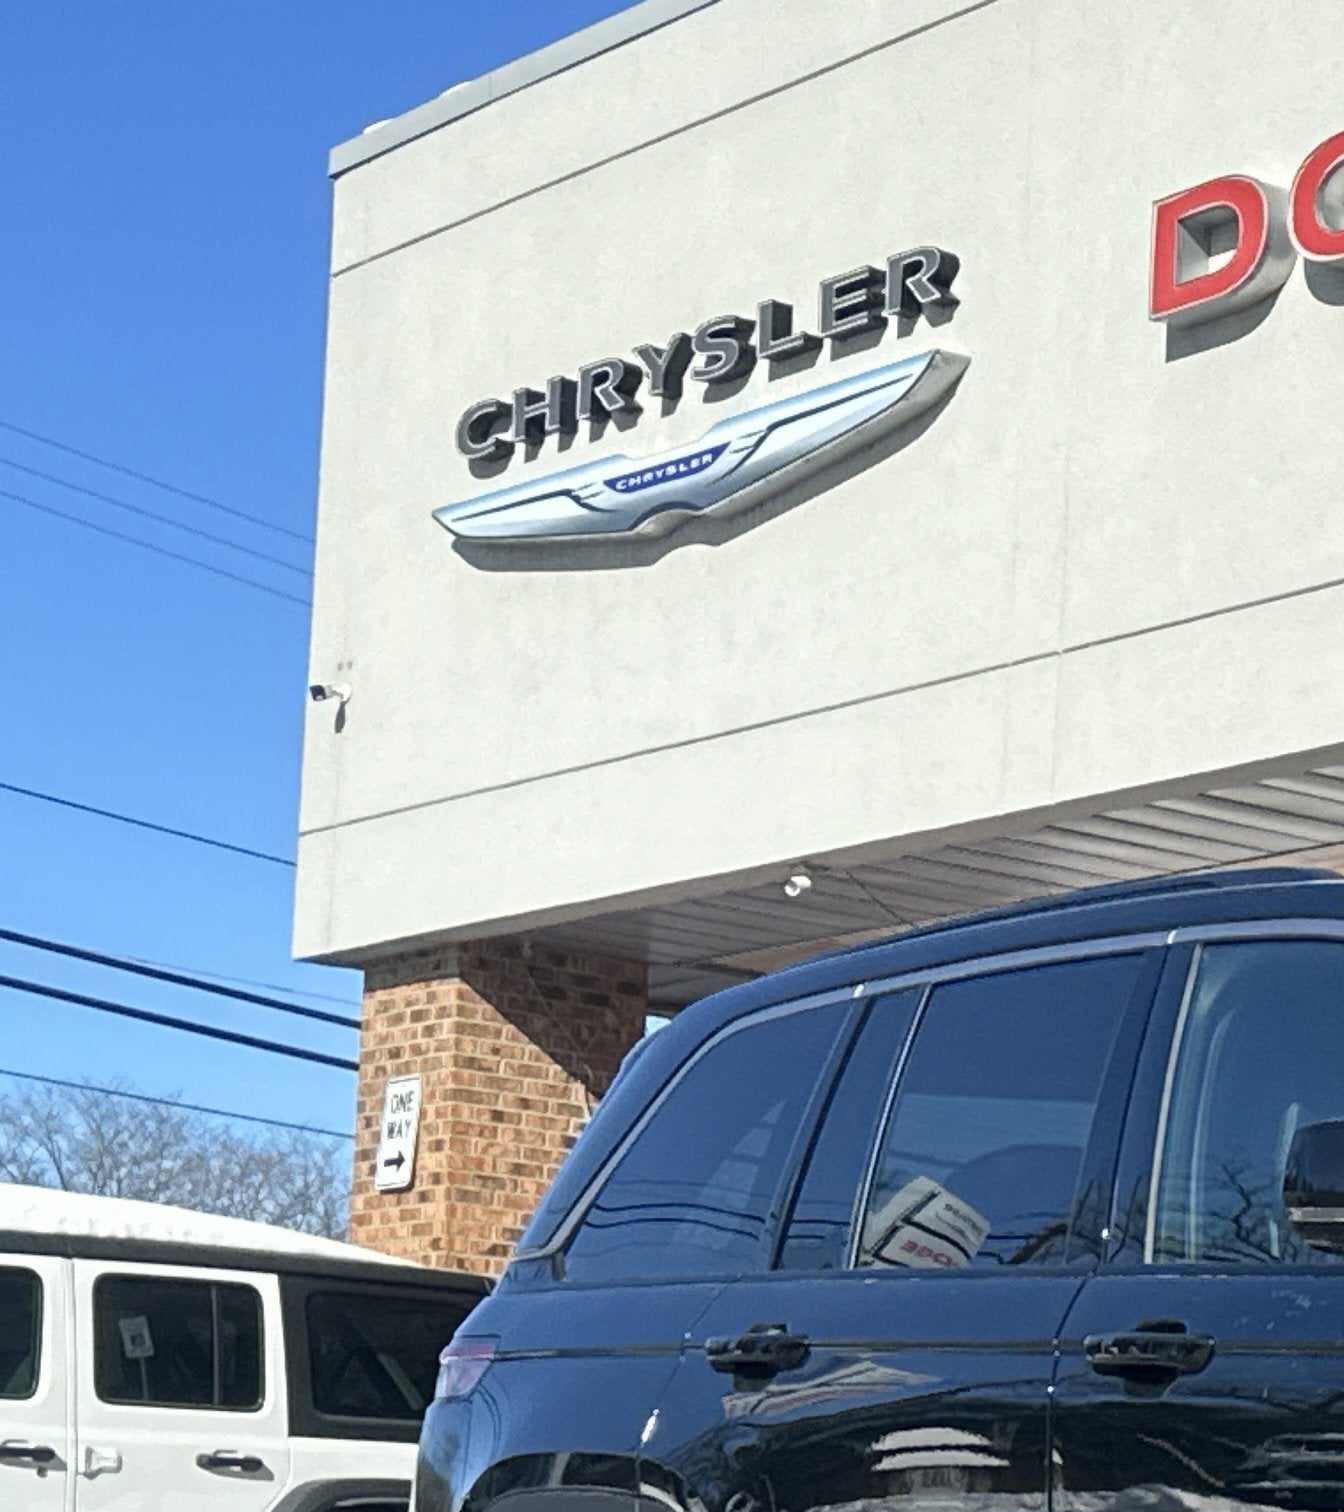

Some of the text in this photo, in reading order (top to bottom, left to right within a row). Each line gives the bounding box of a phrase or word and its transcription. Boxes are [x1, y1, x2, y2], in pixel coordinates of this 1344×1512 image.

[455, 246, 945, 459] CHRYSLER
[615, 453, 713, 490] CHRYSLER
[390, 1090, 415, 1115] ONE
[387, 1119, 412, 1140] WAY
